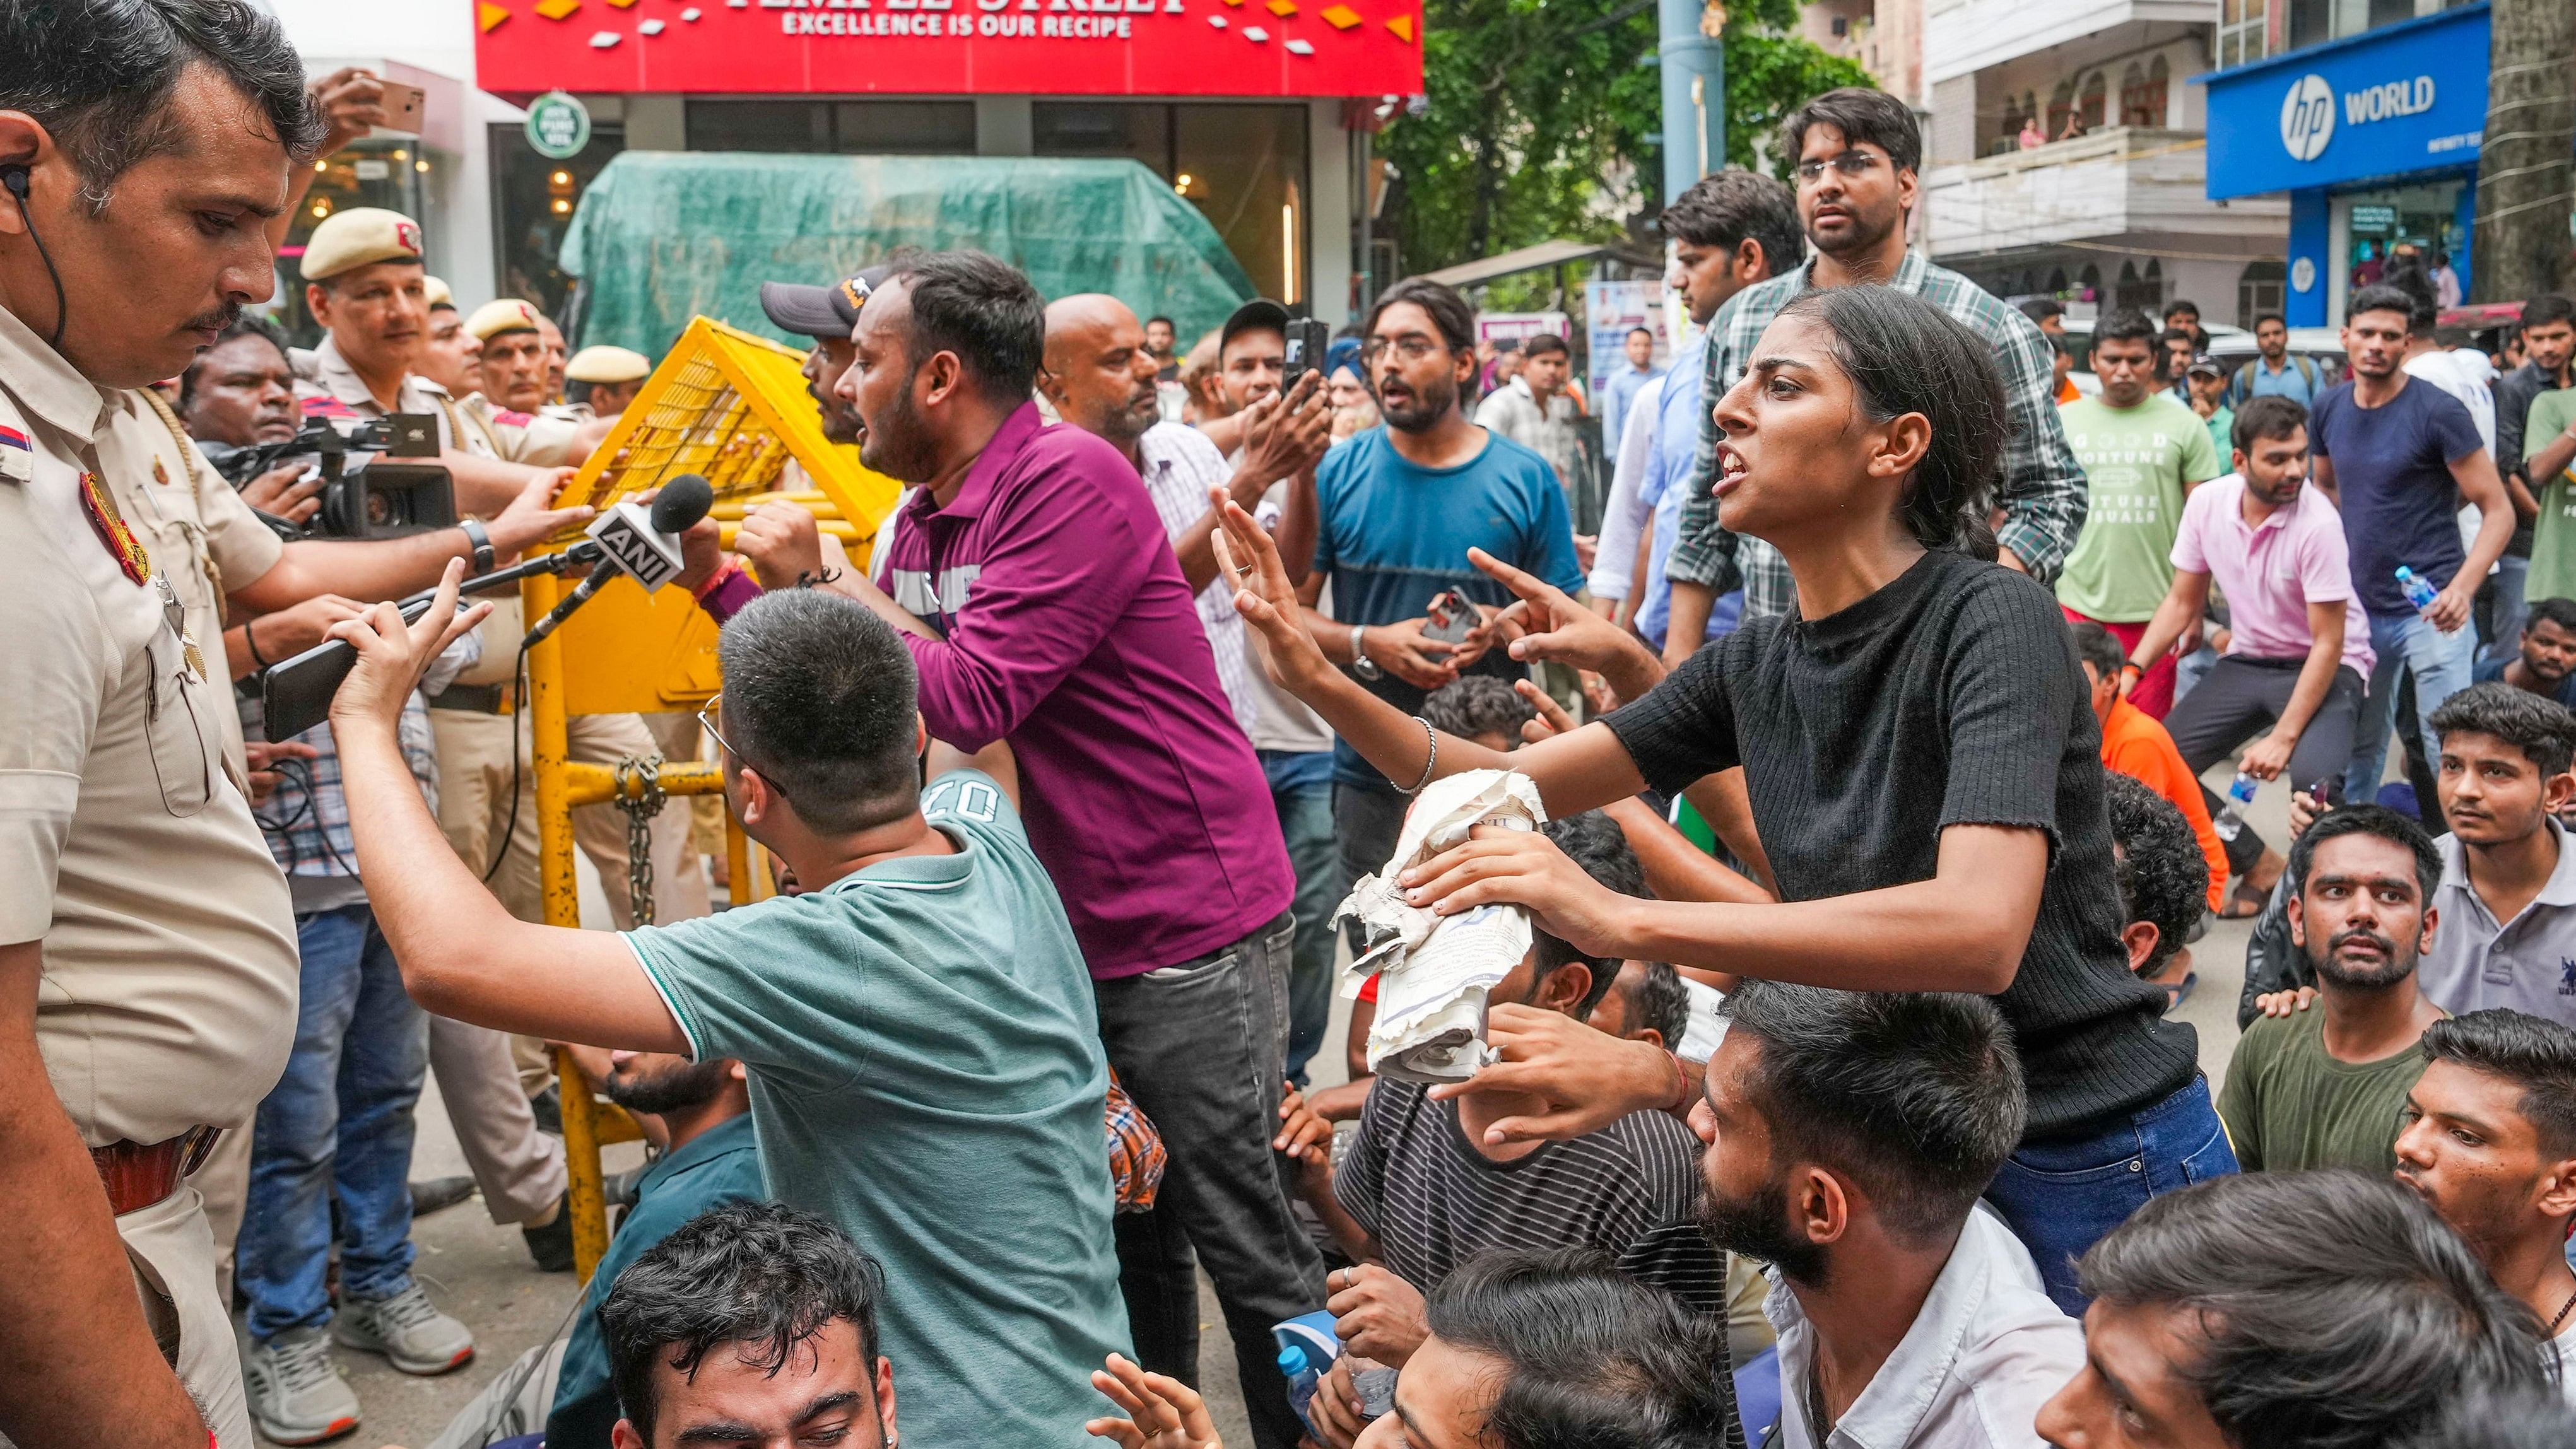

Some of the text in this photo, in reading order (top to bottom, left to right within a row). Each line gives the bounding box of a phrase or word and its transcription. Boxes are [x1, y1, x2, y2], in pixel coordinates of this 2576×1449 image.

[782, 12, 1131, 38] EXCELLENCE IS OUR RECIPE
[2285, 75, 2436, 160] hp WORLD
[602, 528, 666, 581] ANI
